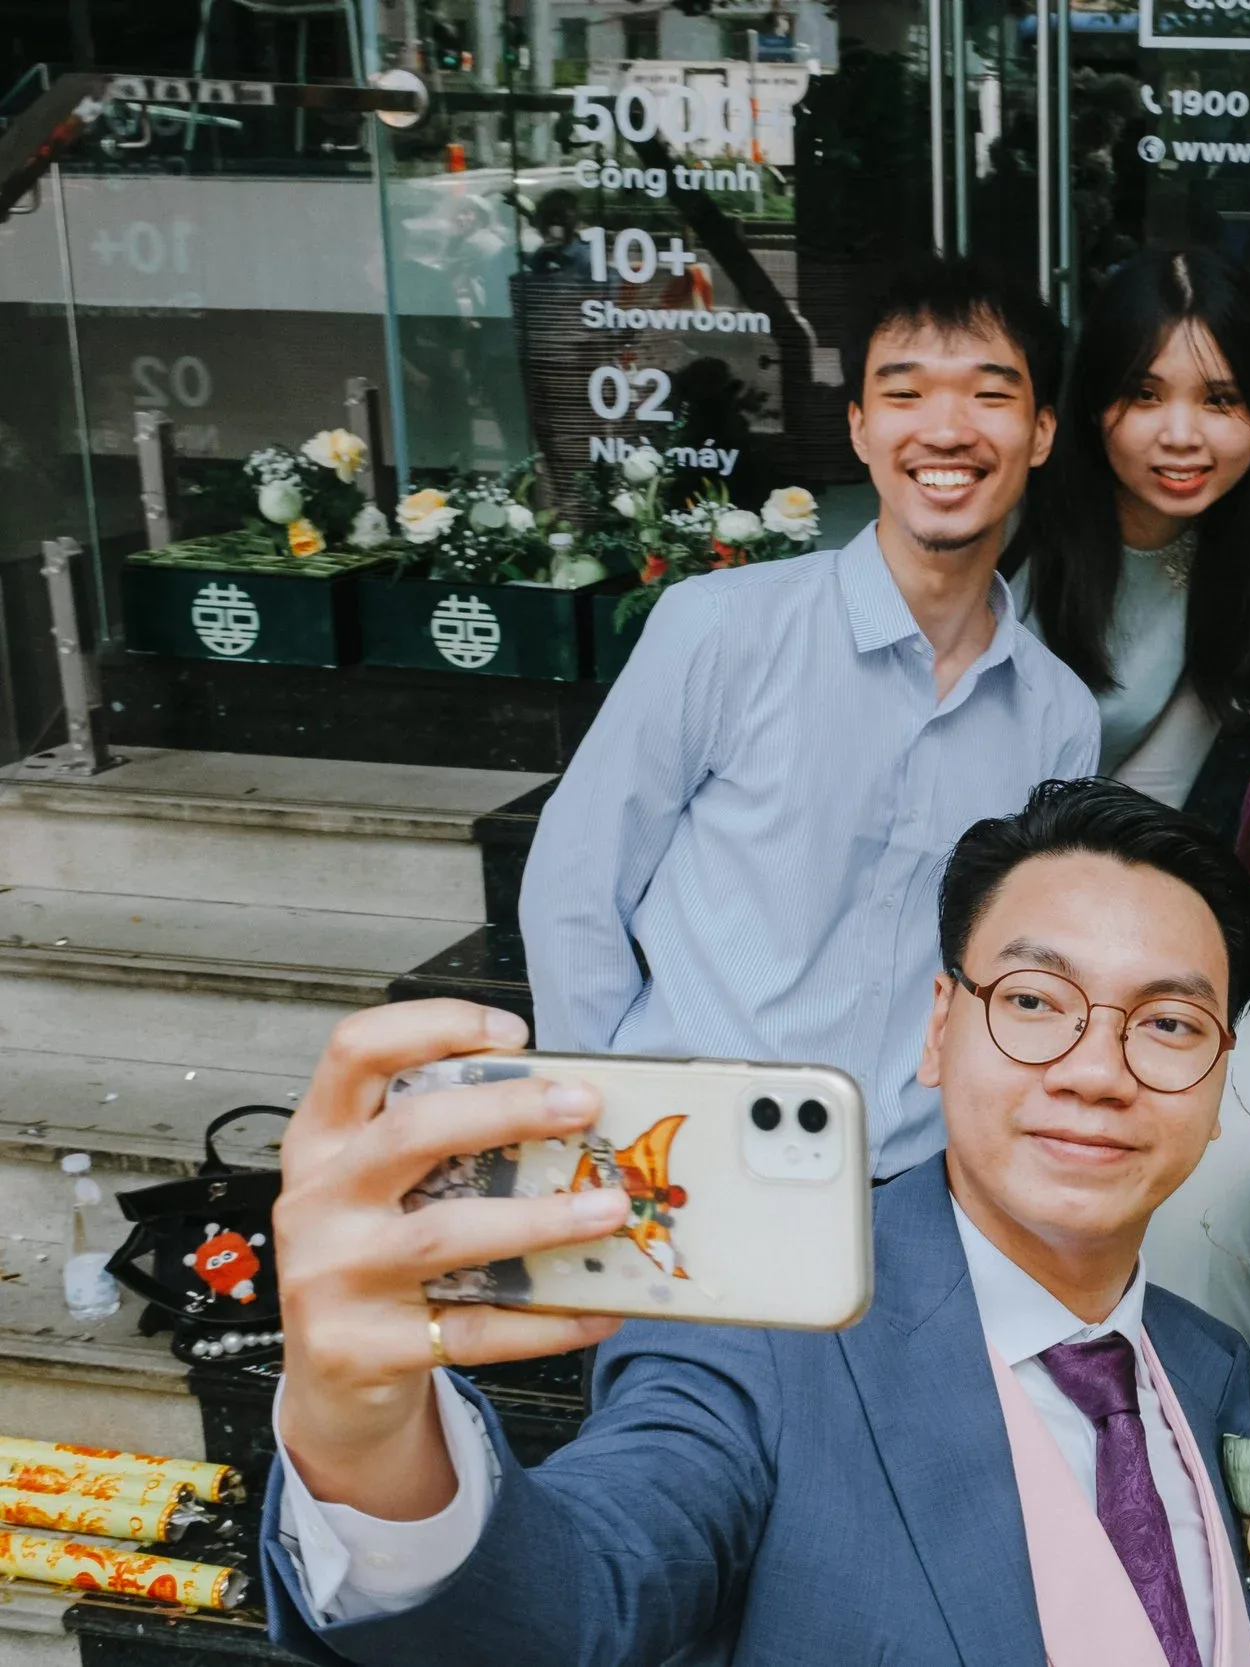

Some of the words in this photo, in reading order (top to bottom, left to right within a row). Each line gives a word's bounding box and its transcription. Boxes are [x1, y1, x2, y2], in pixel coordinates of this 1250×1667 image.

[1169, 89, 1249, 117] 1900
[575, 159, 668, 198] Công
[673, 160, 761, 191] trình
[580, 226, 697, 284] 10+
[581, 300, 772, 334] Showroom
[588, 366, 674, 422] 02
